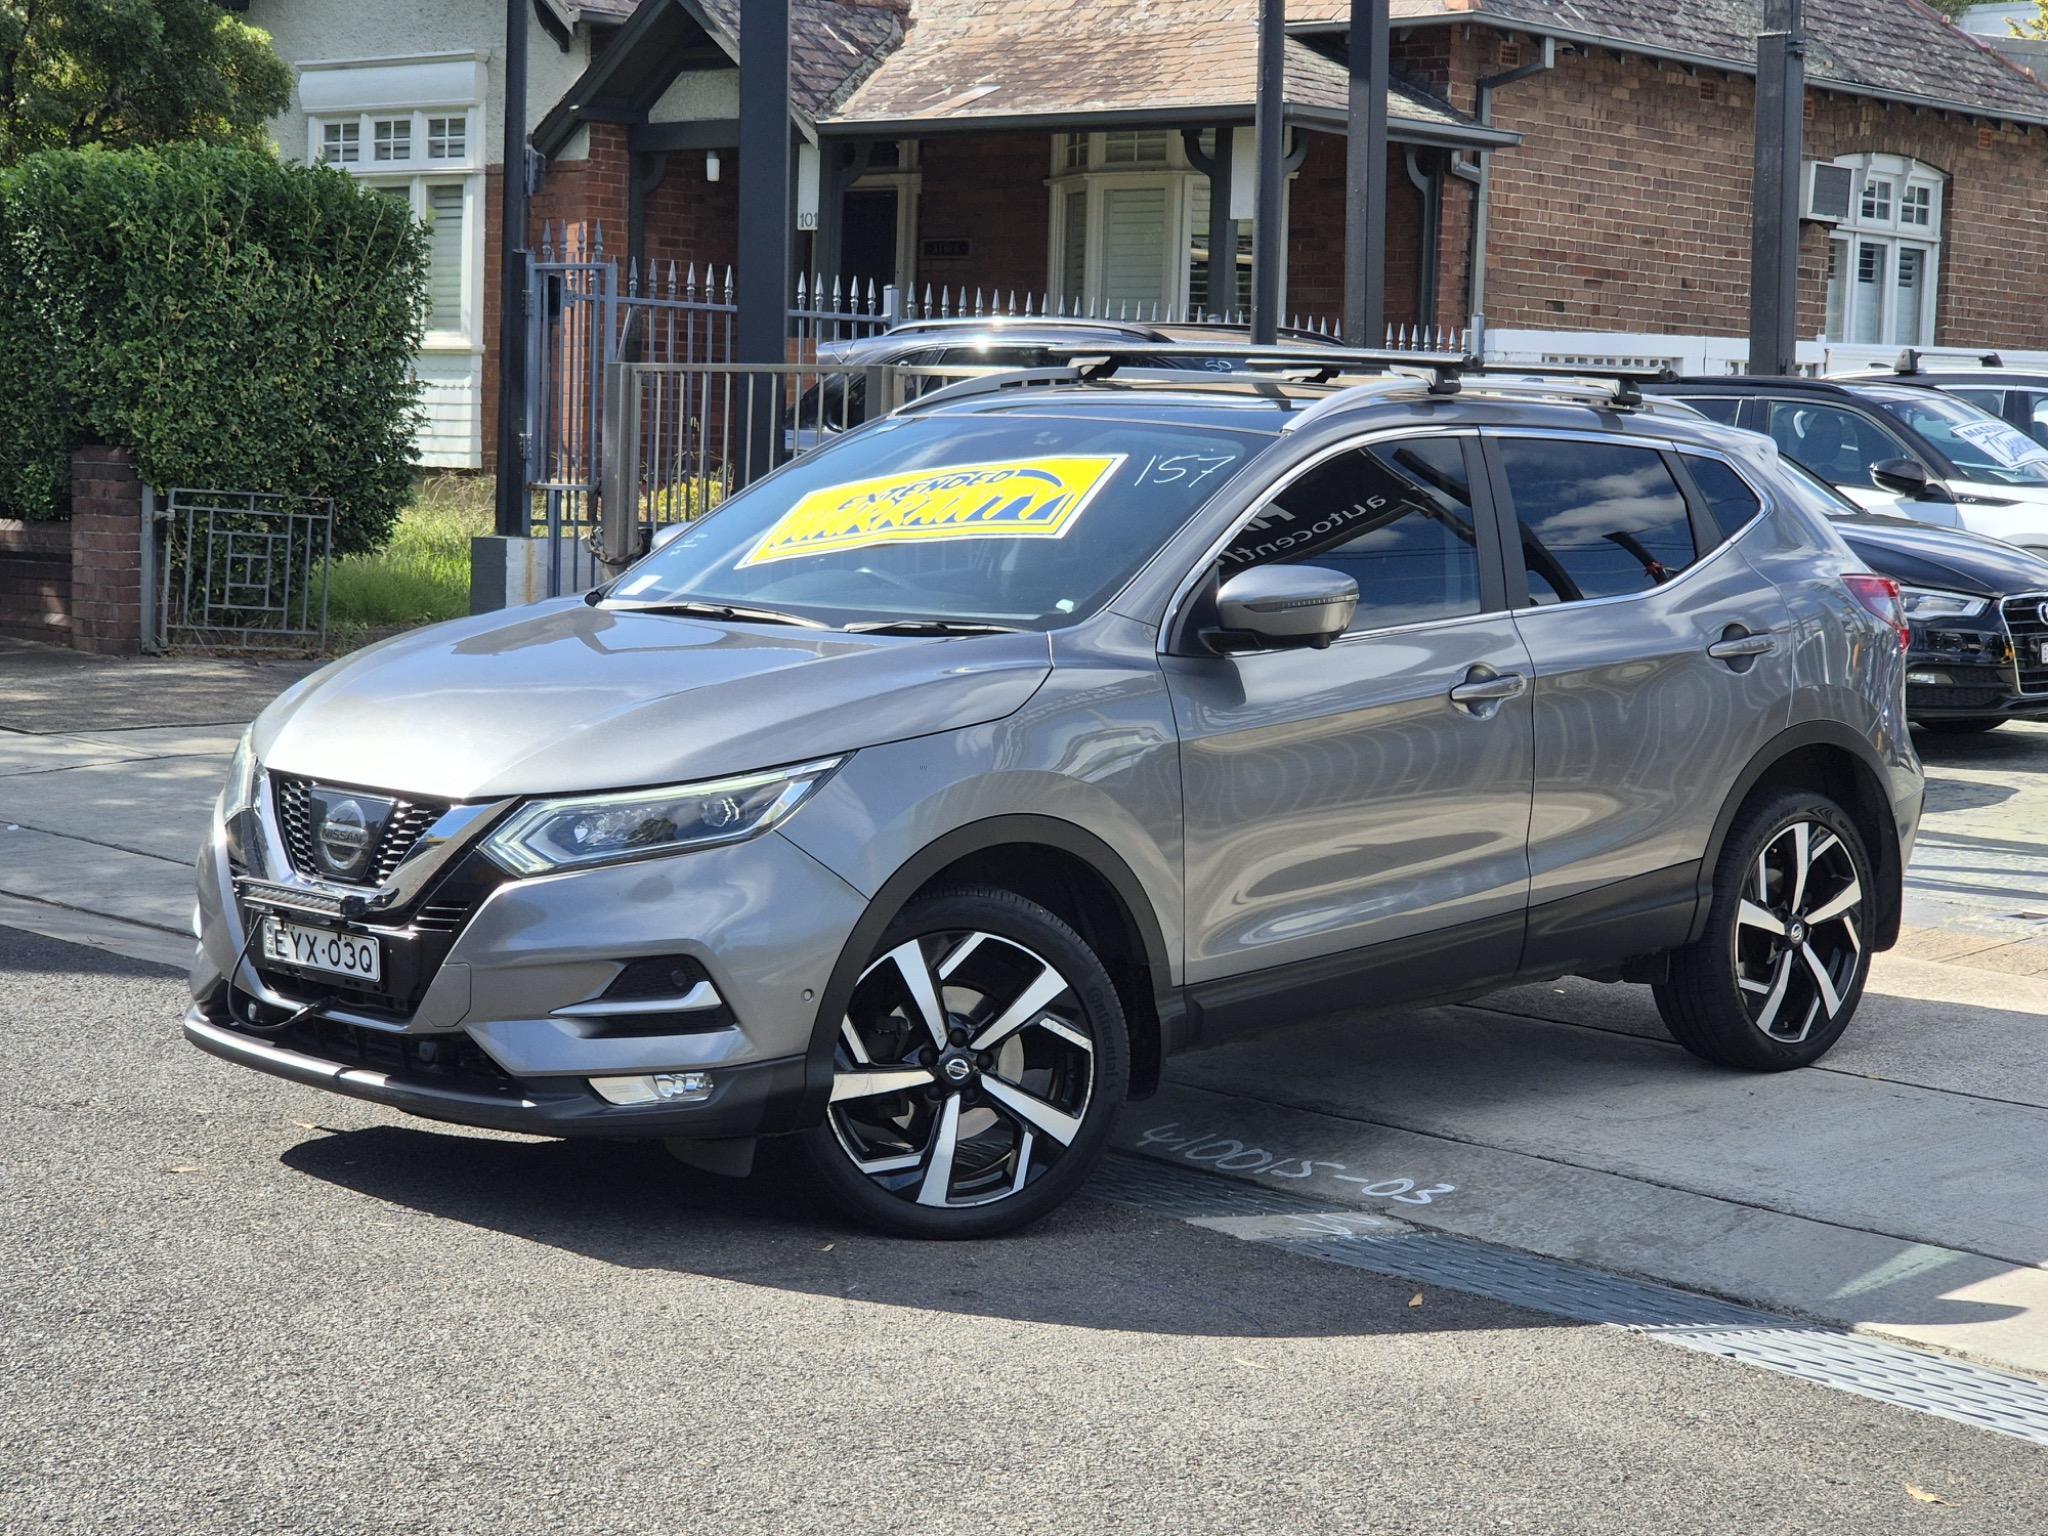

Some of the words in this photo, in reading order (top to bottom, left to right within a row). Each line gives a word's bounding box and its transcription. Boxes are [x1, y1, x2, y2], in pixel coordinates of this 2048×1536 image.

[1134, 454, 1236, 488] 157
[837, 469, 1018, 511] EXTENDED
[321, 828, 367, 844] NISSAN
